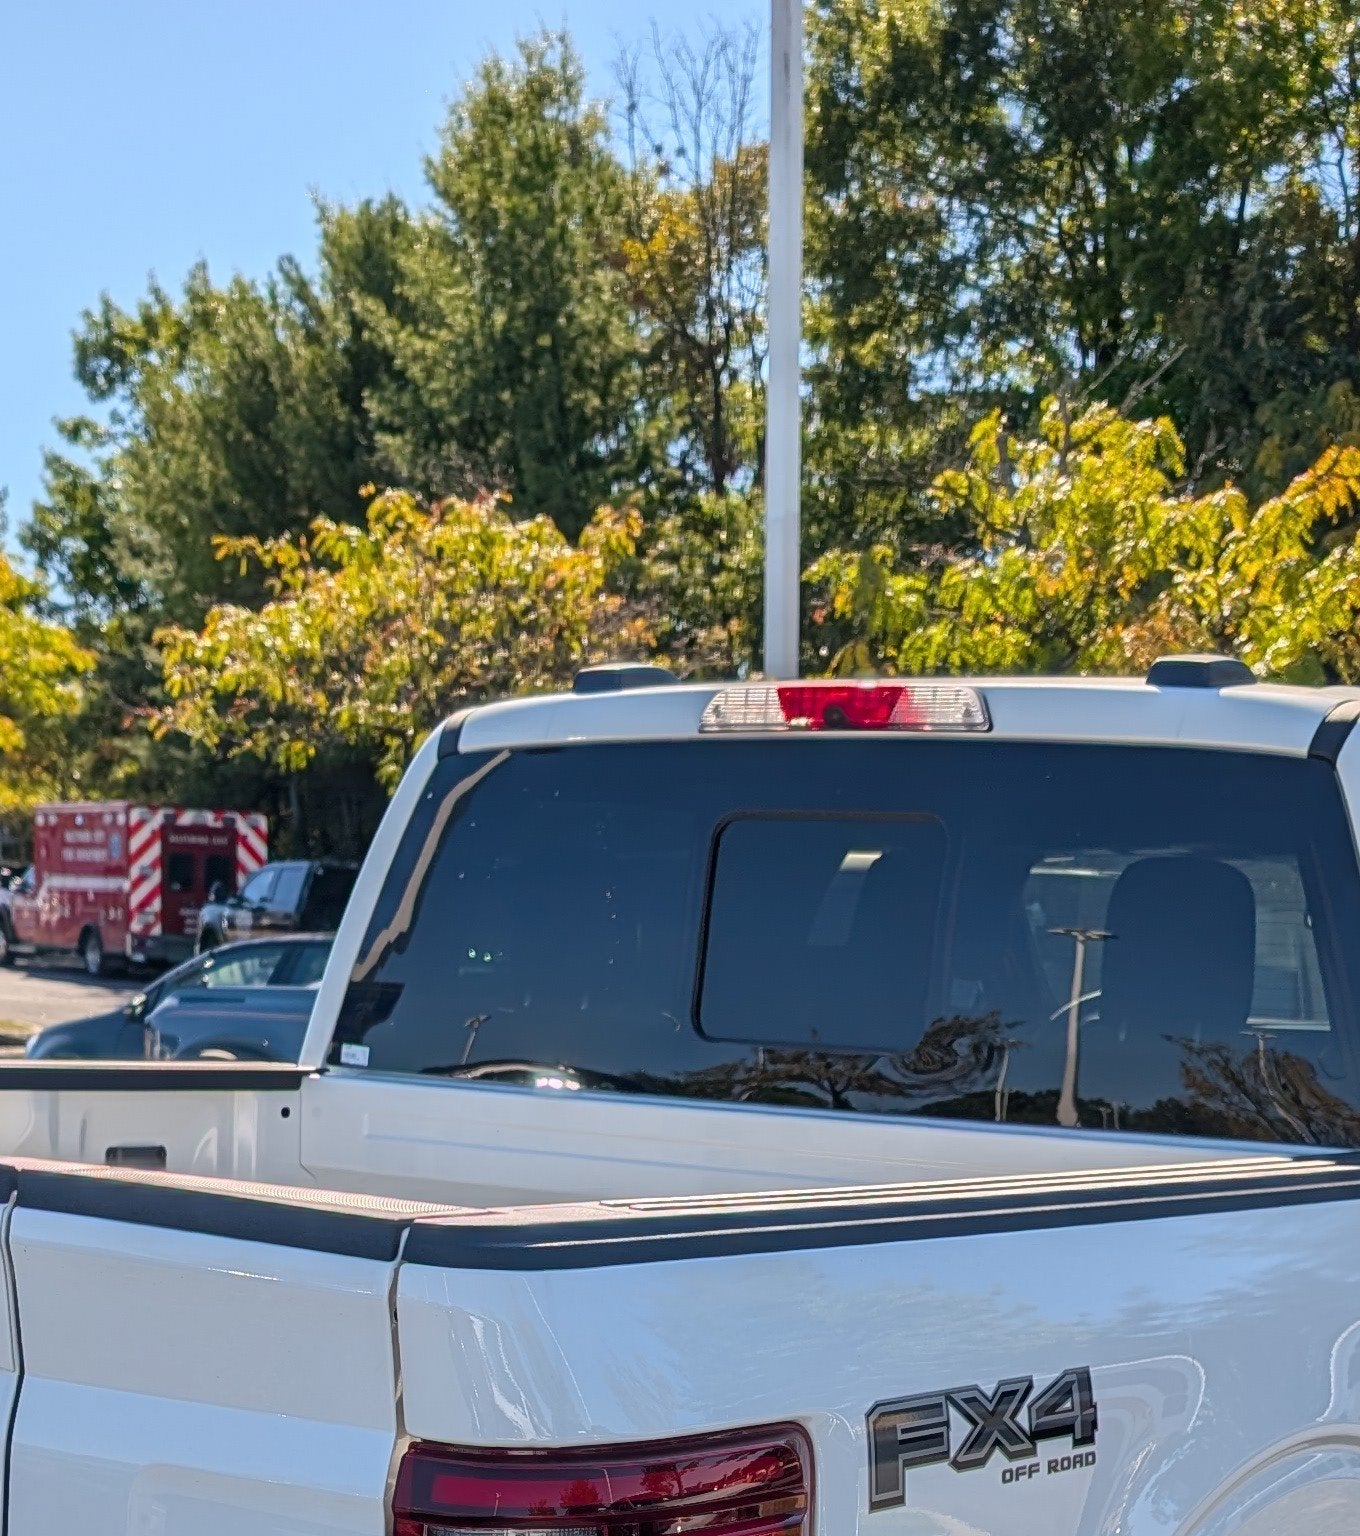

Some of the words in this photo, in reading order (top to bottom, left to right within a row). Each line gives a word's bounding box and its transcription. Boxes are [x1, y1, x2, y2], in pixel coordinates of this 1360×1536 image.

[864, 1365, 1099, 1514] FX4
[1001, 1462, 1041, 1484] OFF
[1047, 1450, 1097, 1476] ROAD
